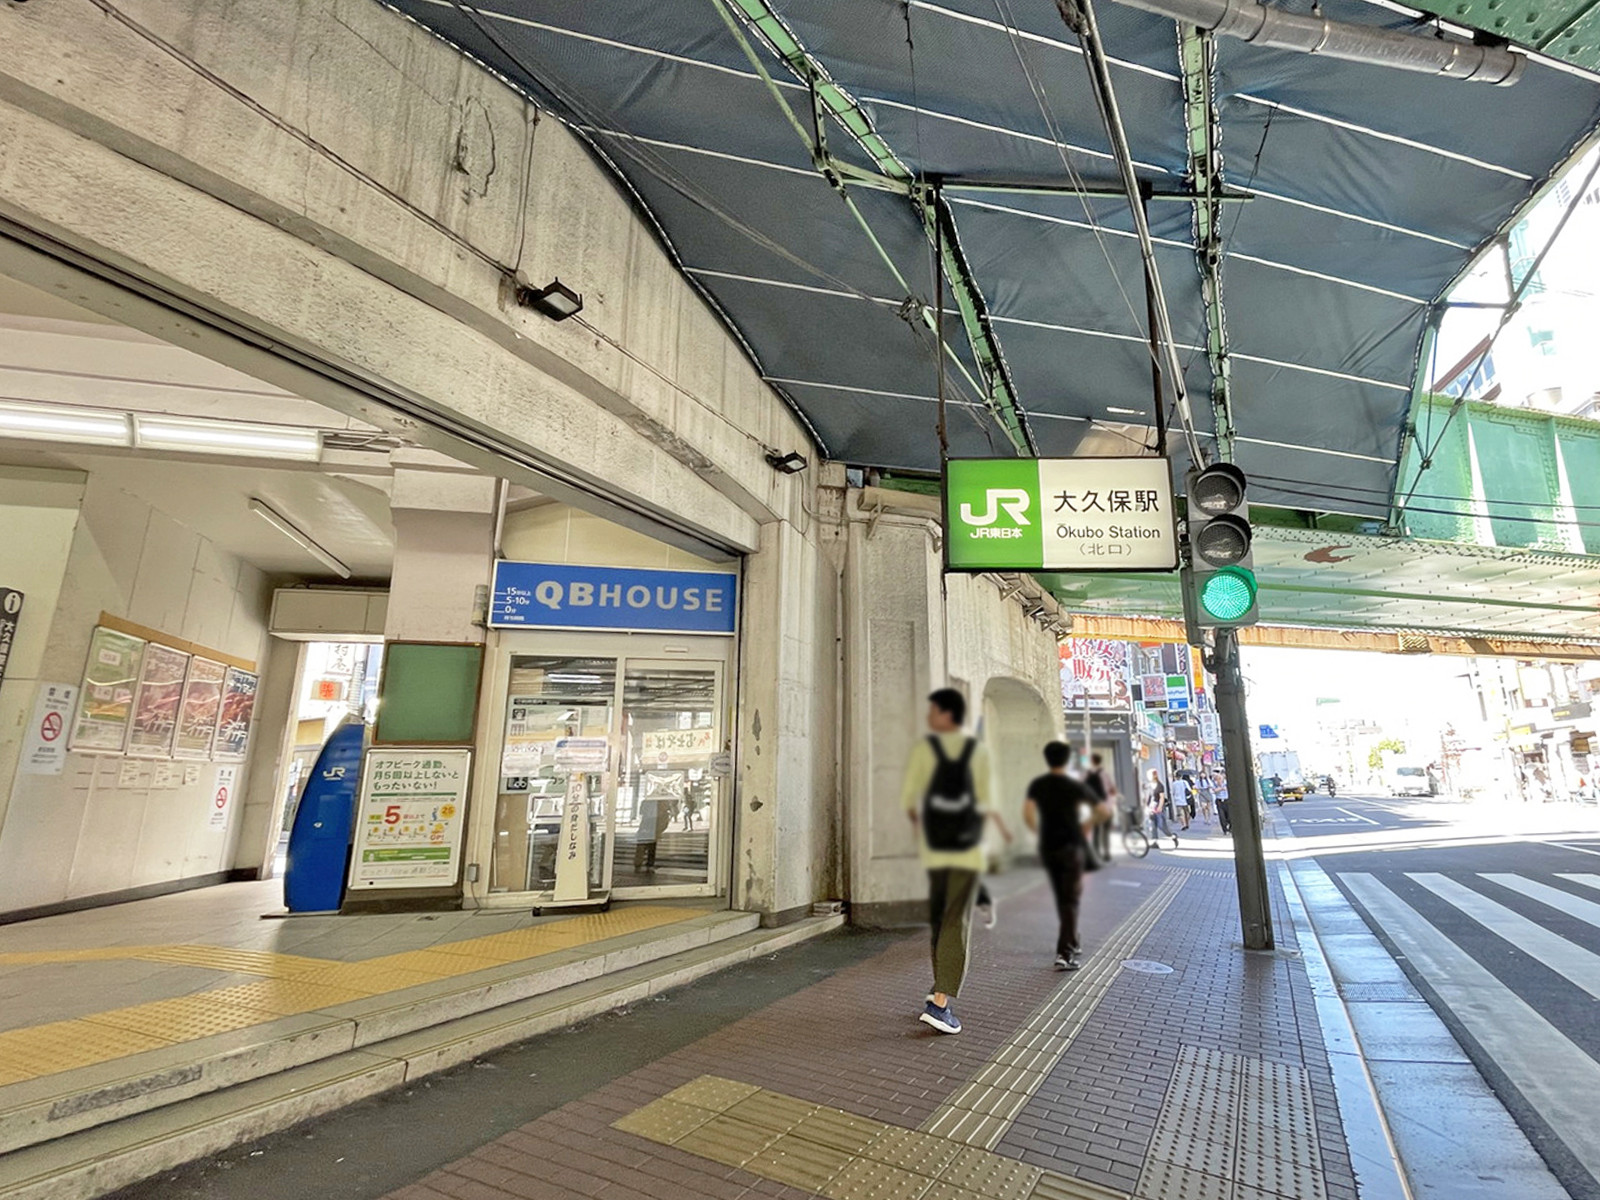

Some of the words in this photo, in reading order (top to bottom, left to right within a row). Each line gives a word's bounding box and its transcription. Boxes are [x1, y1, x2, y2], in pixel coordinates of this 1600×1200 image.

[960, 488, 1031, 526] JR
[1053, 490, 1159, 513] 大久保駅
[970, 527, 1023, 539] JR東日本
[1056, 523, 1104, 538] Ōkubo
[1109, 525, 1160, 538] Station
[323, 767, 345, 777] JR
[384, 805, 401, 825] 5
